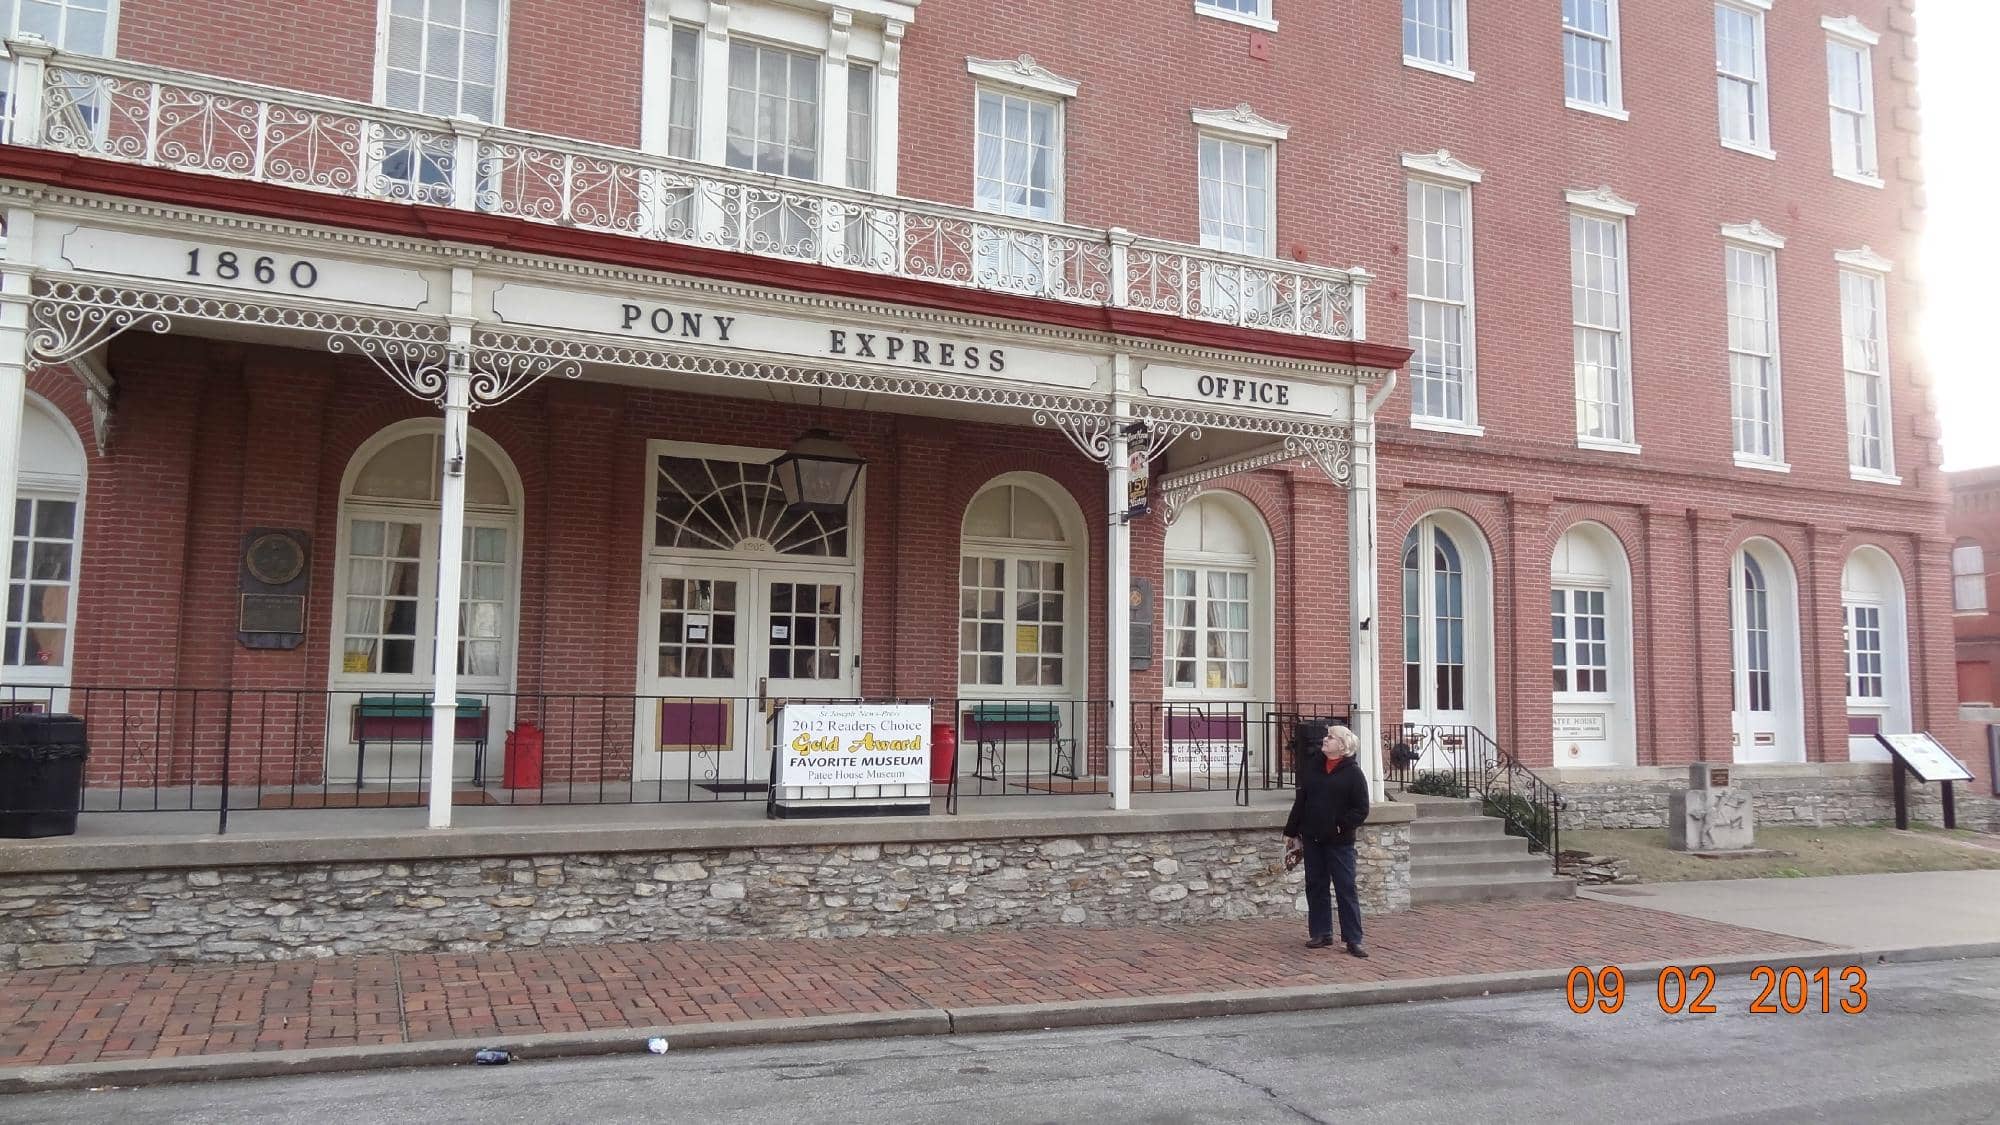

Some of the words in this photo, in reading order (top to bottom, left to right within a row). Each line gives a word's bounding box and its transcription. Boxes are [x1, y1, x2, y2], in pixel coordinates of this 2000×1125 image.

[186, 247, 318, 289] 1860
[621, 304, 735, 341] PONY
[830, 329, 1005, 372] EXPRESS
[1197, 375, 1289, 405] OFFICE
[792, 720, 823, 731] 2012
[828, 720, 877, 731] Readers
[880, 719, 922, 731] Choice
[791, 732, 840, 756] Gold
[848, 732, 922, 753] Award
[790, 757, 857, 767] FAVORITE
[862, 756, 923, 766] MUSEUM
[808, 771, 833, 780] Patee
[835, 770, 864, 780] House
[867, 769, 905, 779] Museum
